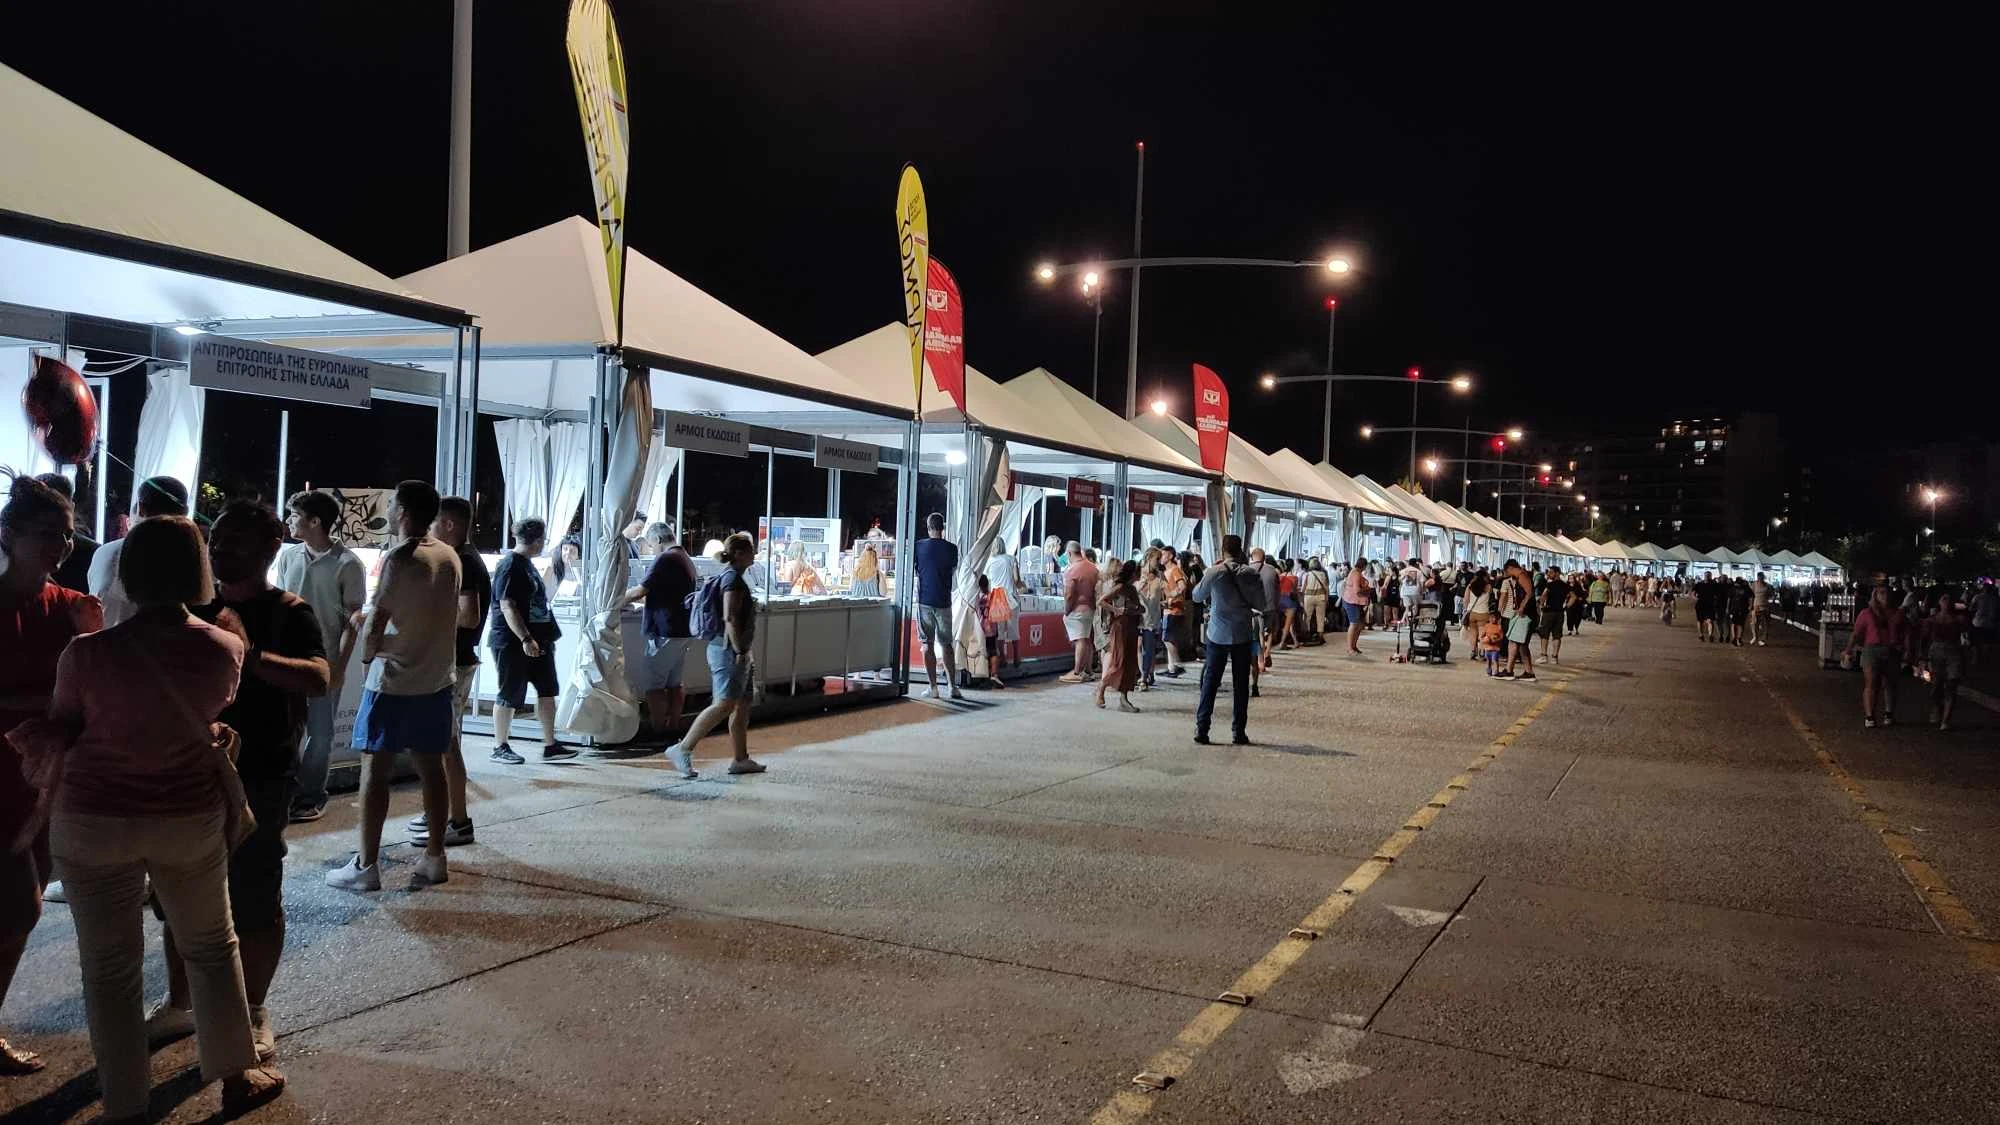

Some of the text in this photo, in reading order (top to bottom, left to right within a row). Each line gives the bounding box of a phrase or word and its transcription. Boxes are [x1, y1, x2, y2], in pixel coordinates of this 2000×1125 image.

[194, 341, 284, 366] ΑΝΤΙΠΡΟΣΩΠΕΙΑ
[287, 354, 306, 370] ΤΗΣ
[216, 359, 350, 391] ΕΠΙΤΡΟΠΗΣ ΣΤΗΝ ΕΛΛΑΔΑ
[675, 423, 742, 443] ΑΡΜΟΣ ΕΚΔΟΣΕΙΣ
